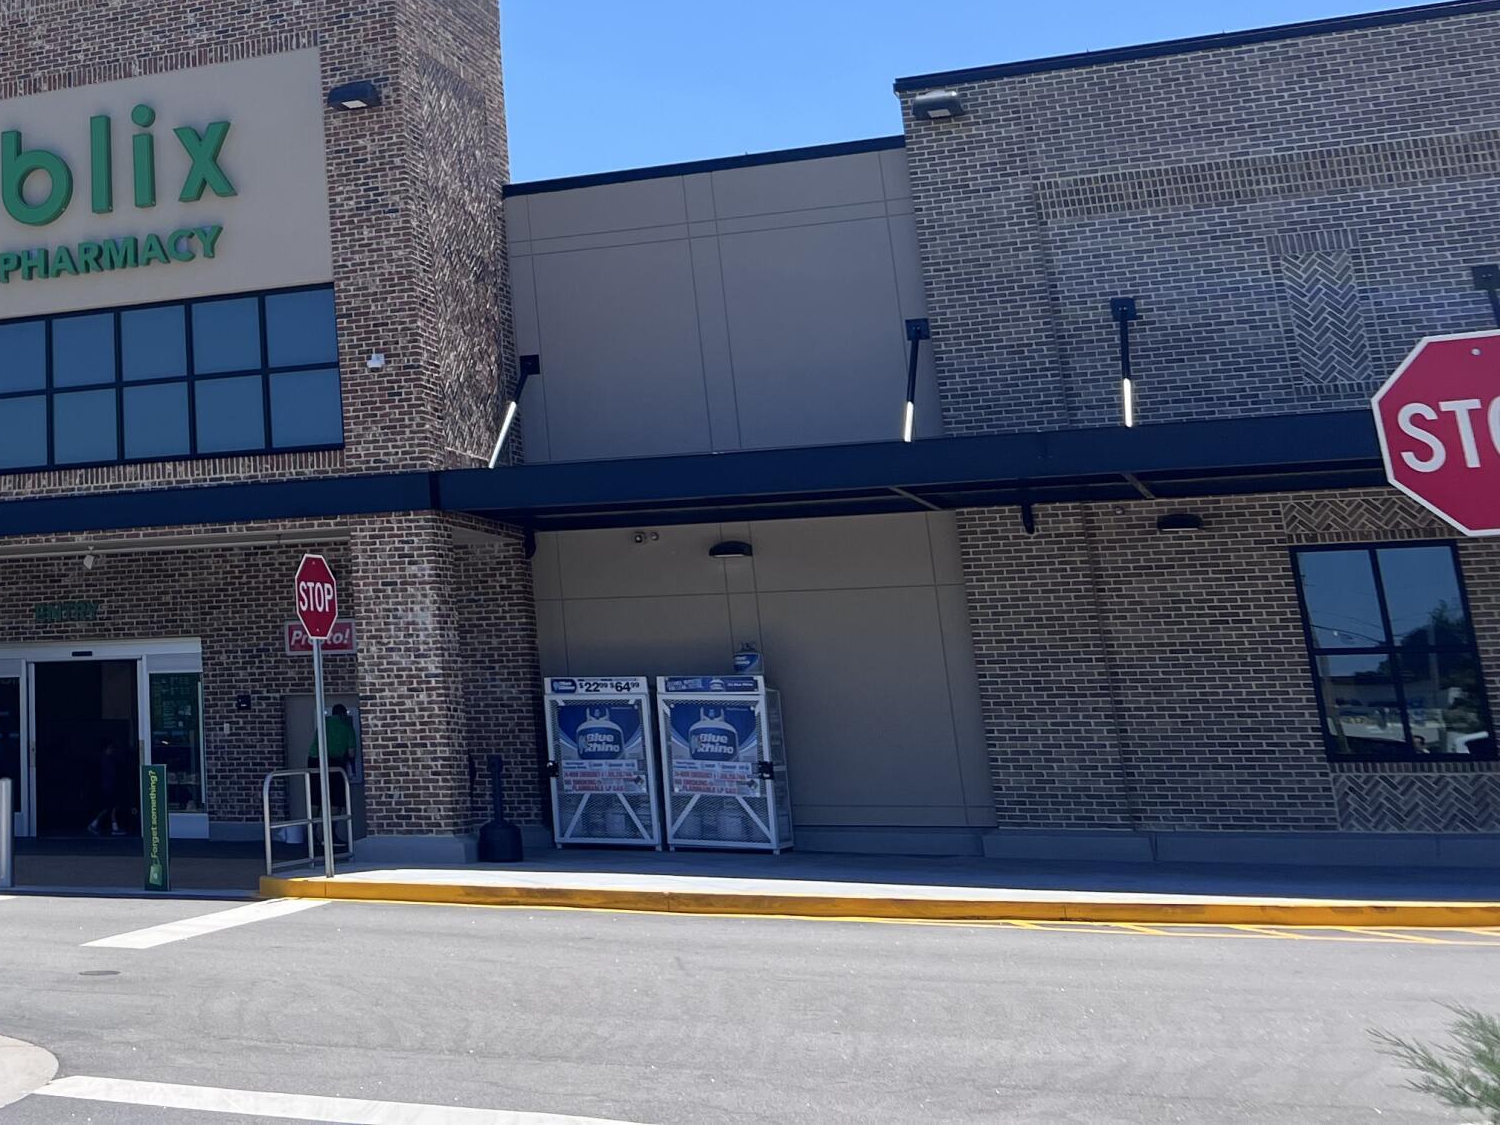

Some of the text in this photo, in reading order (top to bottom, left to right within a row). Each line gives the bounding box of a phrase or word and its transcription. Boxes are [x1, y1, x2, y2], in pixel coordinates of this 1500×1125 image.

[299, 580, 334, 613] STOP
[148, 769, 160, 859] Forget something?
